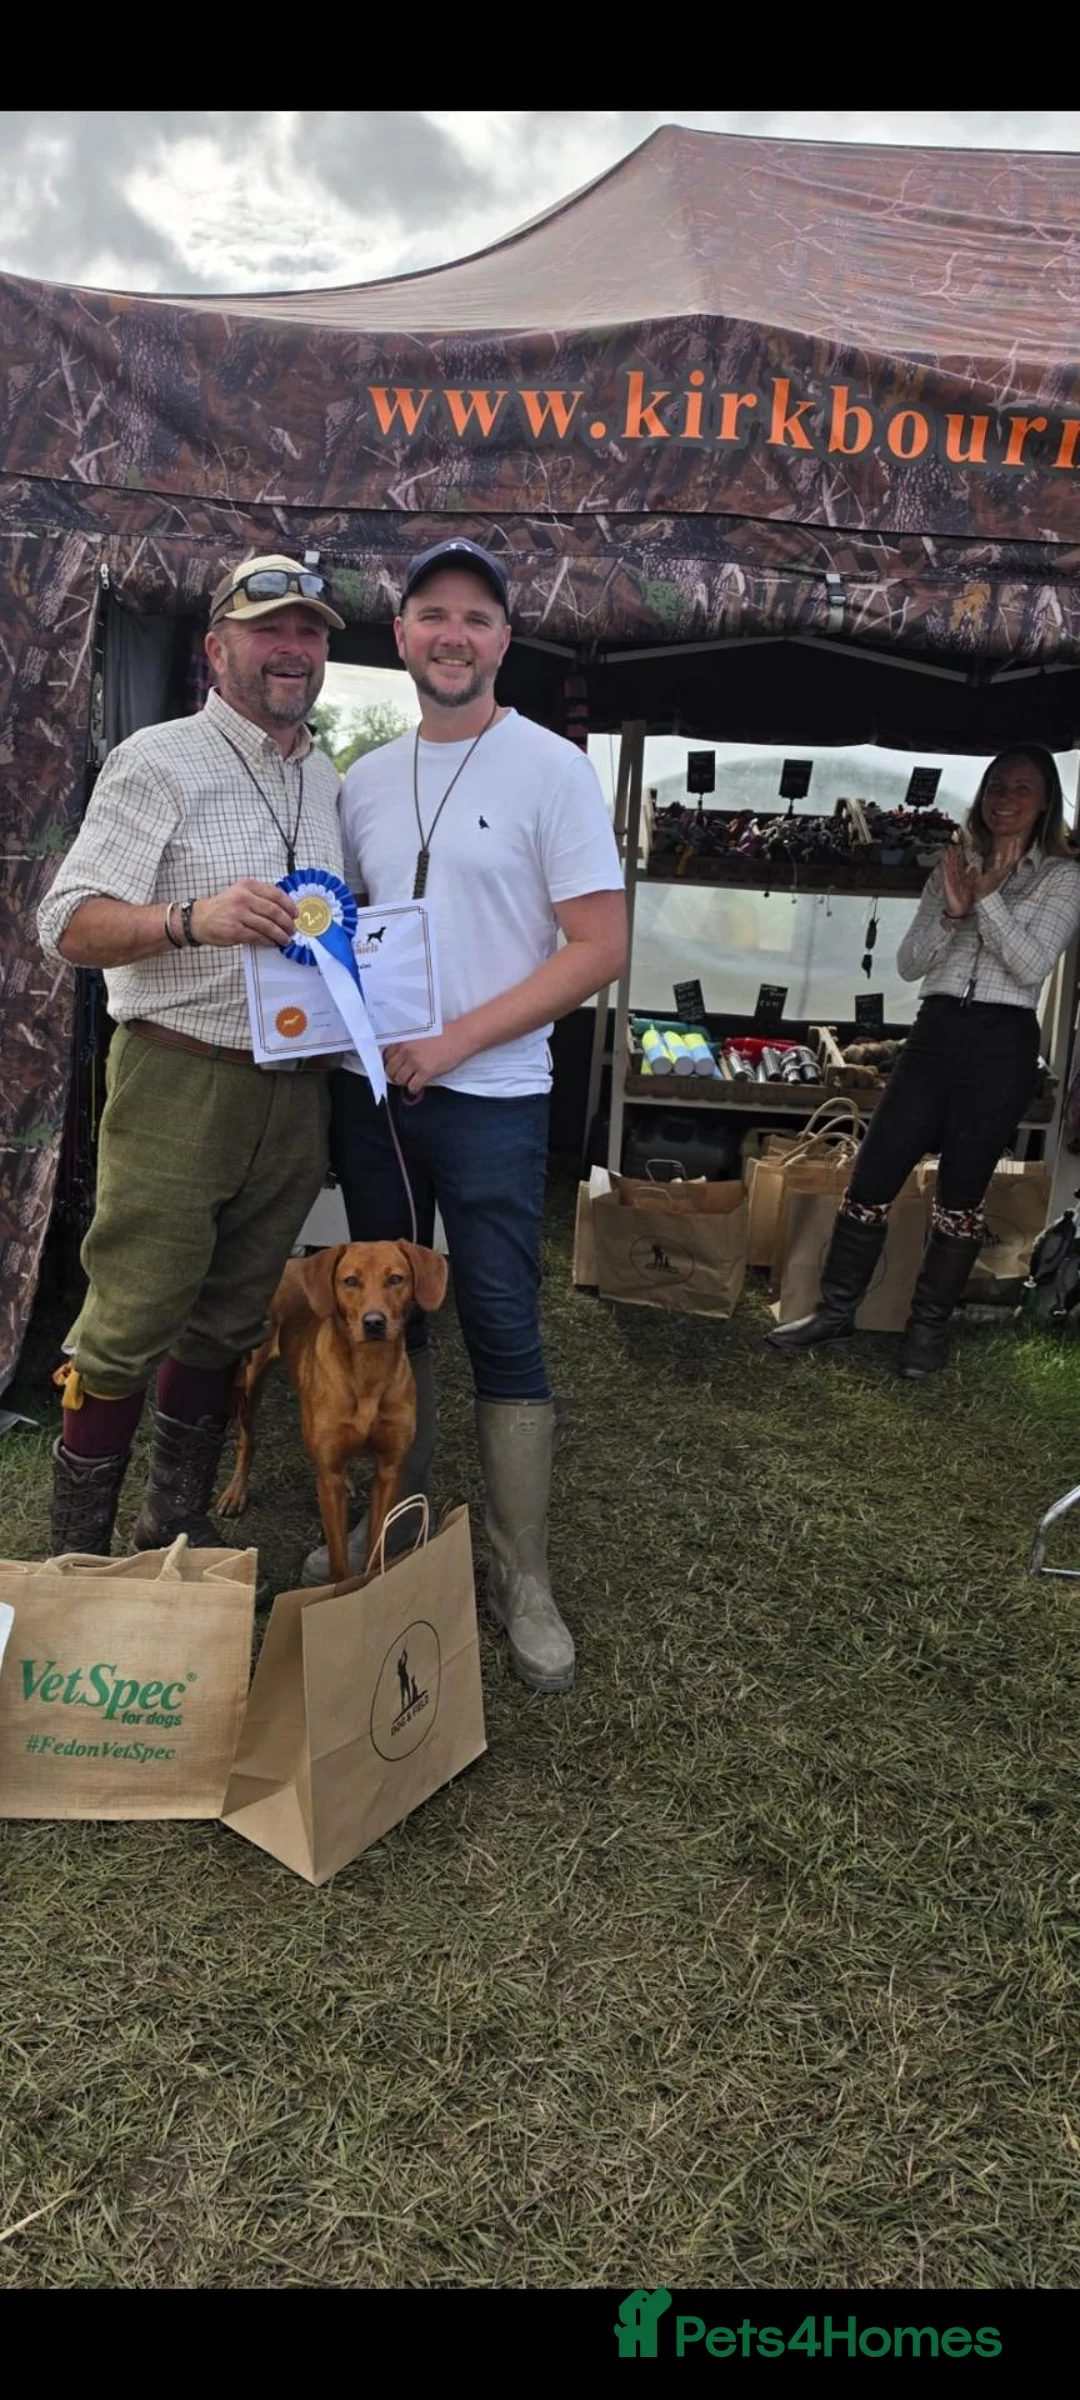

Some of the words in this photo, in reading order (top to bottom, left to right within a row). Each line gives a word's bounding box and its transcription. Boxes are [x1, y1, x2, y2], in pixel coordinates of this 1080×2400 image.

[121, 1711, 143, 1725] for
[146, 1710, 182, 1729] dogs
[25, 1733, 177, 1763] #FedonVetSpec
